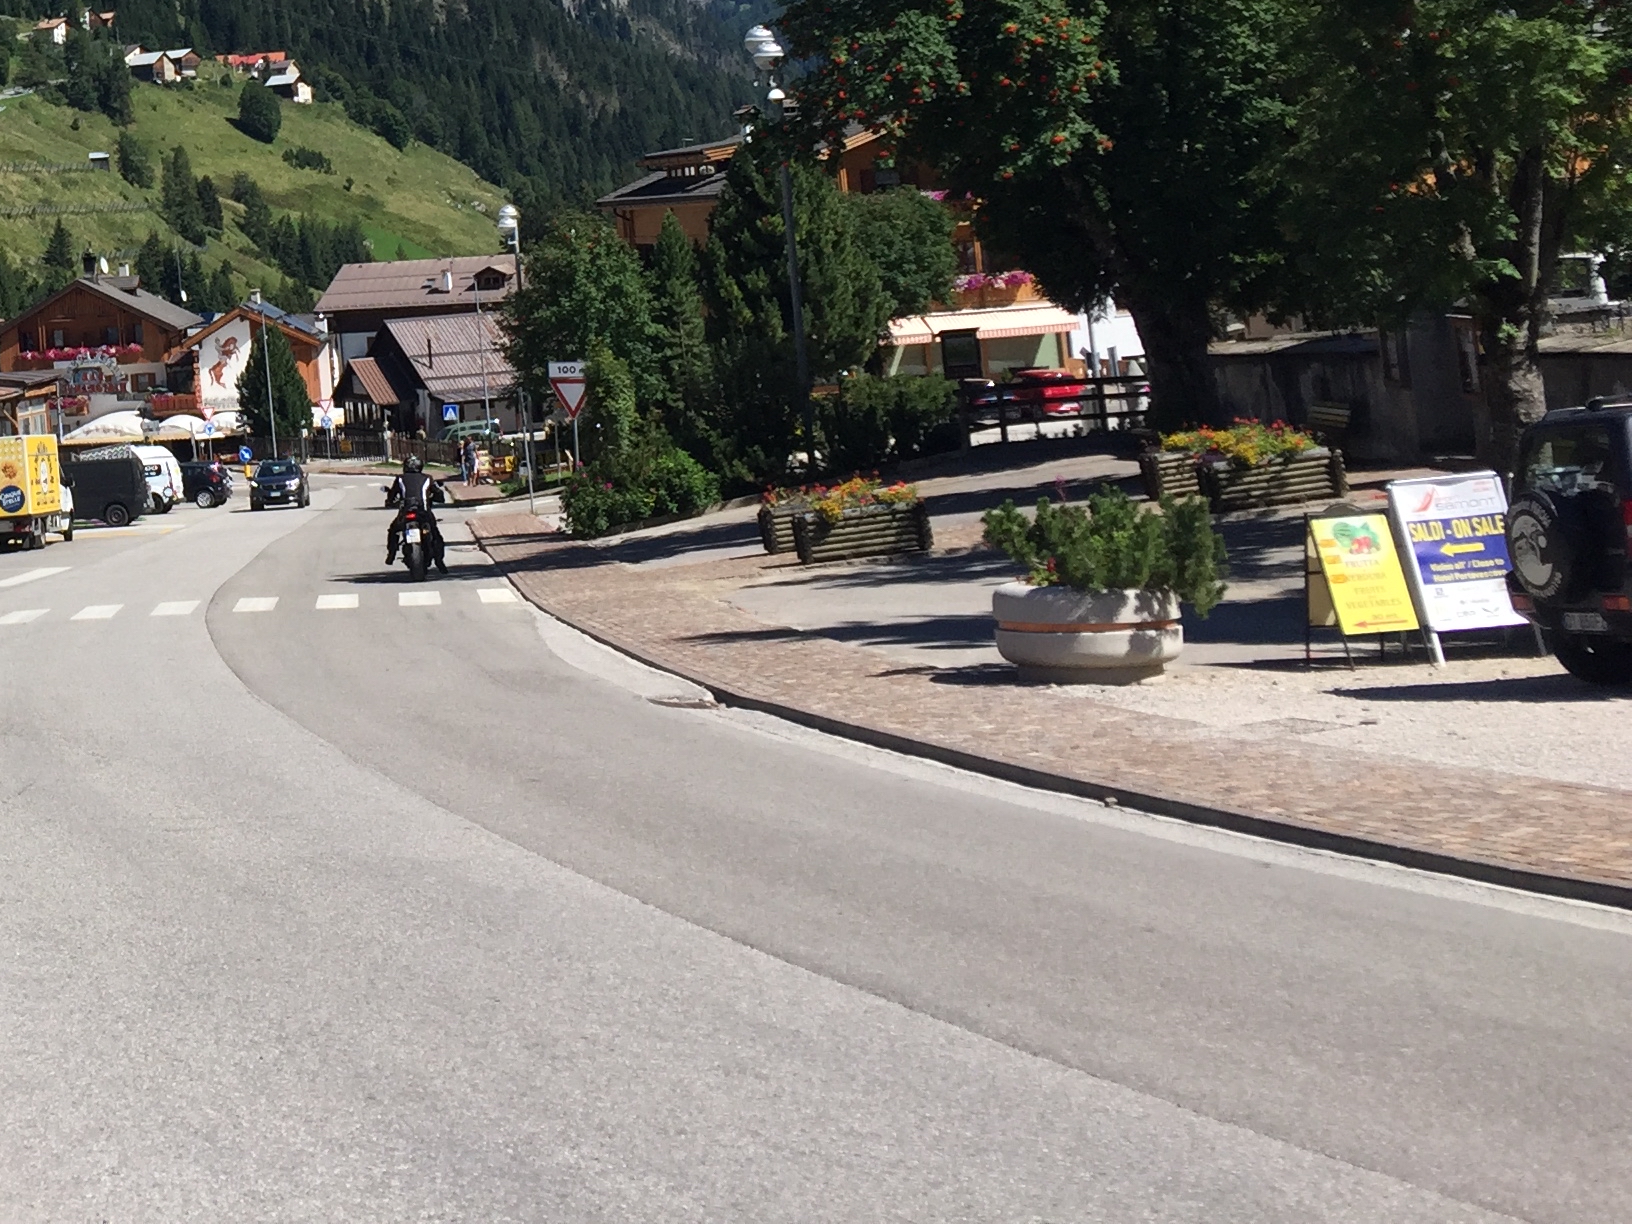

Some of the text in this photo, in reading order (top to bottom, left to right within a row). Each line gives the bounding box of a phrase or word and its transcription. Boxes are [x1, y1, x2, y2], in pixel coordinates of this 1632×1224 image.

[557, 366, 576, 374] 100
[1408, 515, 1506, 543] SALDI ON SALE
